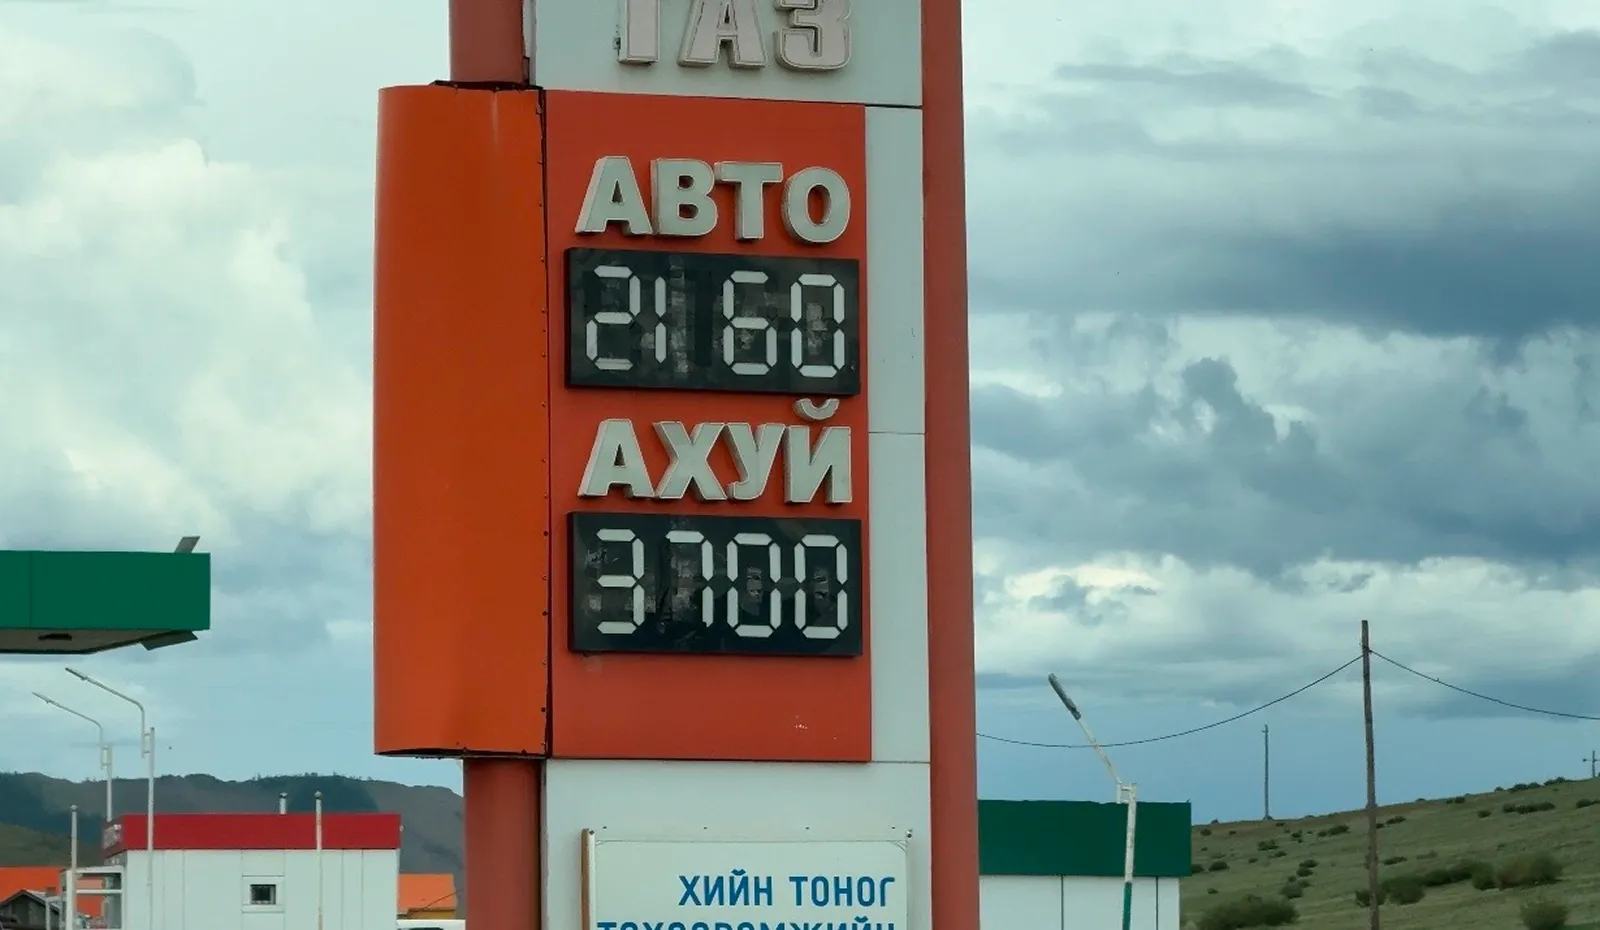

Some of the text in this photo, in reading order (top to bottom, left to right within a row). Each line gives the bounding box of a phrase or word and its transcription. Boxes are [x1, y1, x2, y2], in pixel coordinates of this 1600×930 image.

[575, 155, 851, 244] АВТО
[586, 265, 845, 378] 2160
[577, 398, 852, 504] АХУЙ
[596, 528, 848, 639] 3700
[678, 868, 896, 907] ХИЙН ТОНОГ
